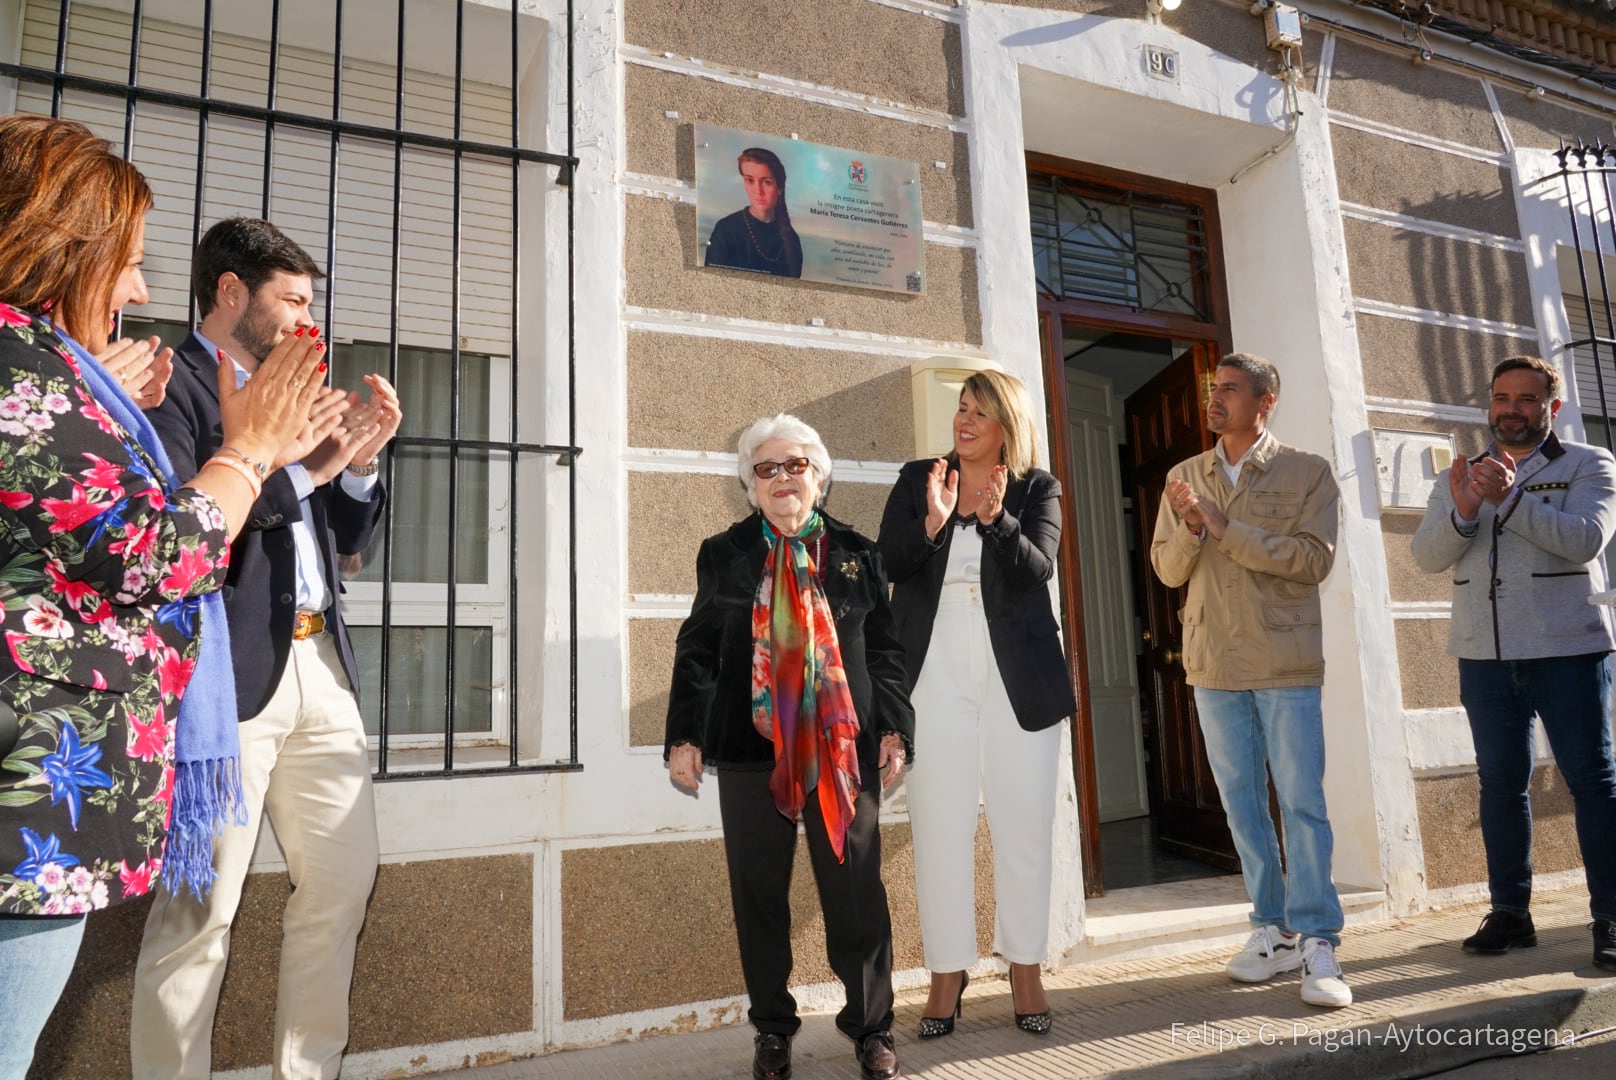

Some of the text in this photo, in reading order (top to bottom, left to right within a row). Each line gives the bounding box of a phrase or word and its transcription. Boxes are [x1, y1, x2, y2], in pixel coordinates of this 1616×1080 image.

[824, 202, 845, 211] insigne
[846, 205, 864, 214] poeta
[864, 208, 899, 218] cartagenera
[829, 211, 849, 219] Teresa
[850, 214, 880, 225] Cervantes
